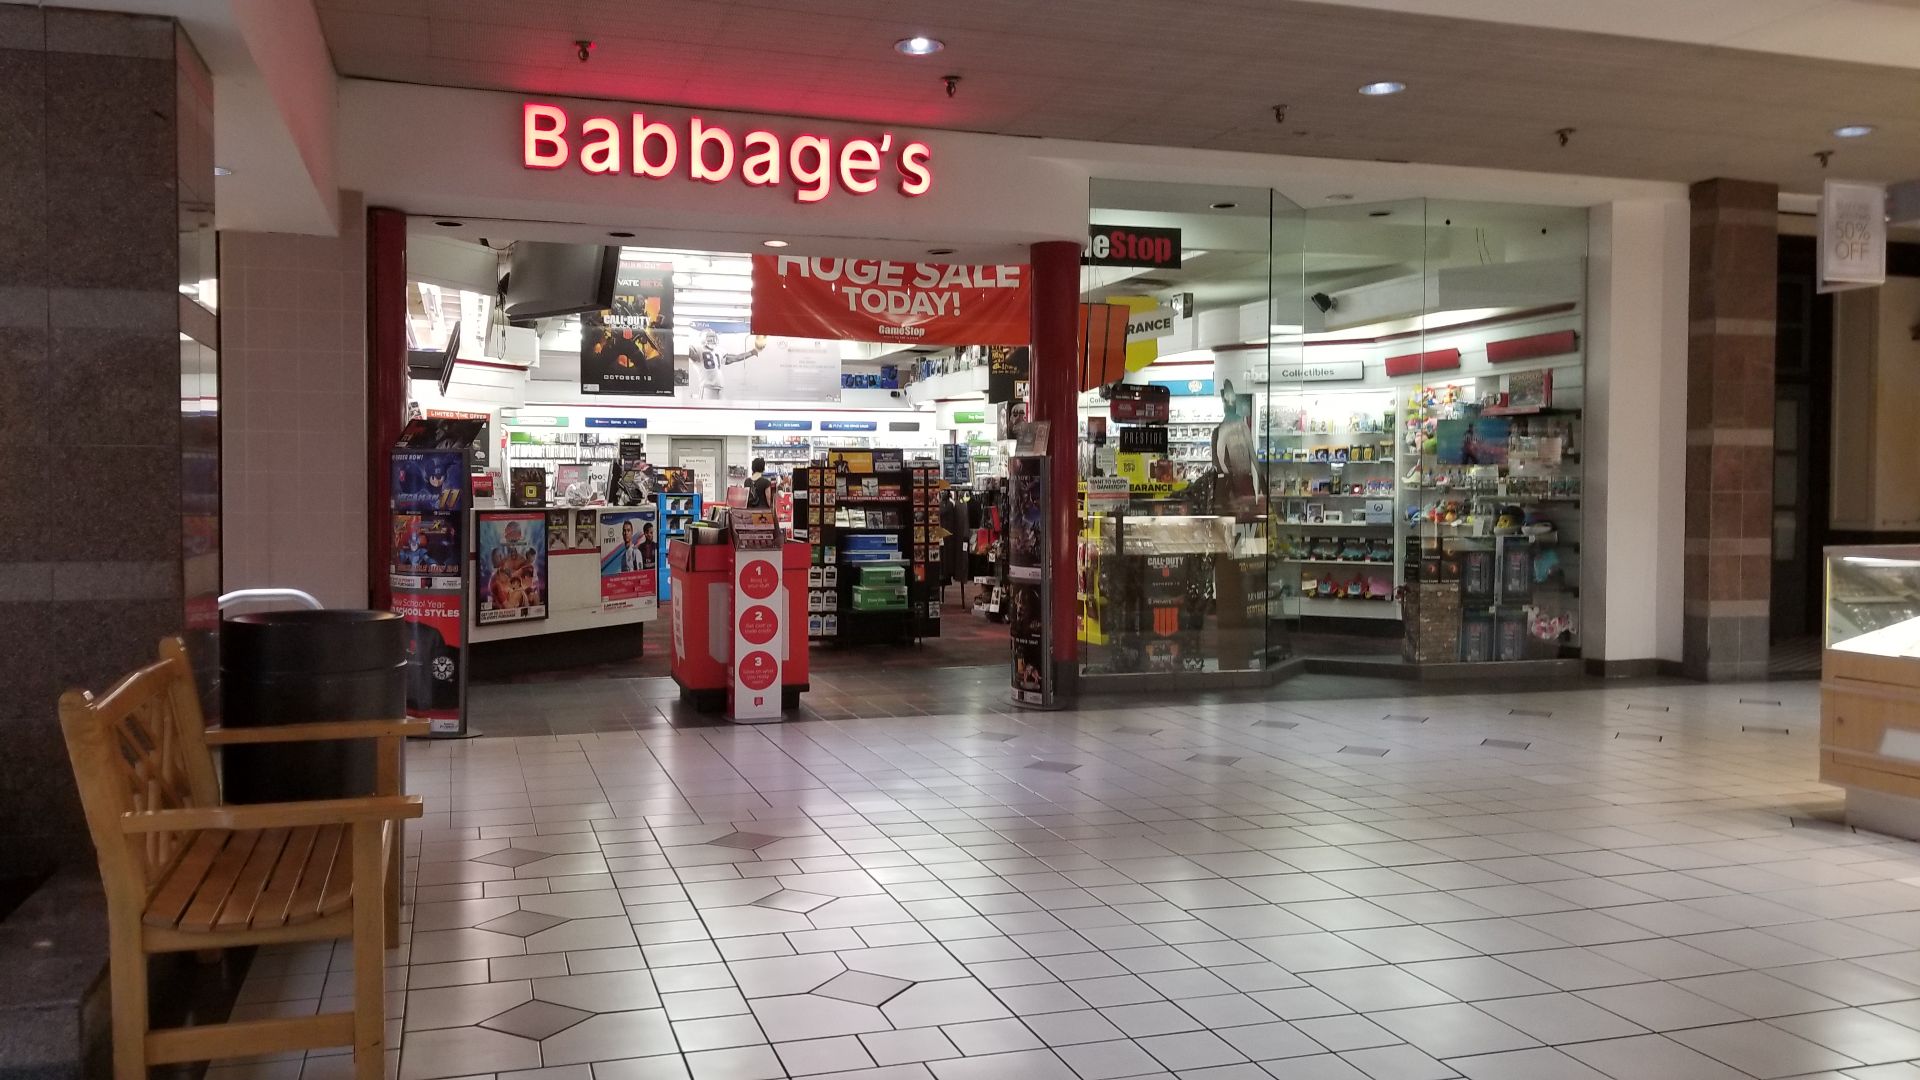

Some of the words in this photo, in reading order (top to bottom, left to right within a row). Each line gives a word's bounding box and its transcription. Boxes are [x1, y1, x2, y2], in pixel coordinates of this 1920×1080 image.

[523, 103, 932, 203] Babbage's
[1836, 221, 1871, 240] 50%
[1835, 241, 1870, 260] OFF
[777, 256, 904, 286] HUGE
[912, 262, 1020, 288] SALE
[842, 286, 961, 316] TODAY!
[878, 325, 925, 337] GameStop
[1282, 367, 1335, 378] Collectibles
[755, 566, 762, 576] 1
[402, 600, 426, 608] School
[427, 601, 446, 609] Year
[424, 609, 460, 618] STYLES
[754, 611, 763, 621] 2
[754, 657, 763, 667] 3
